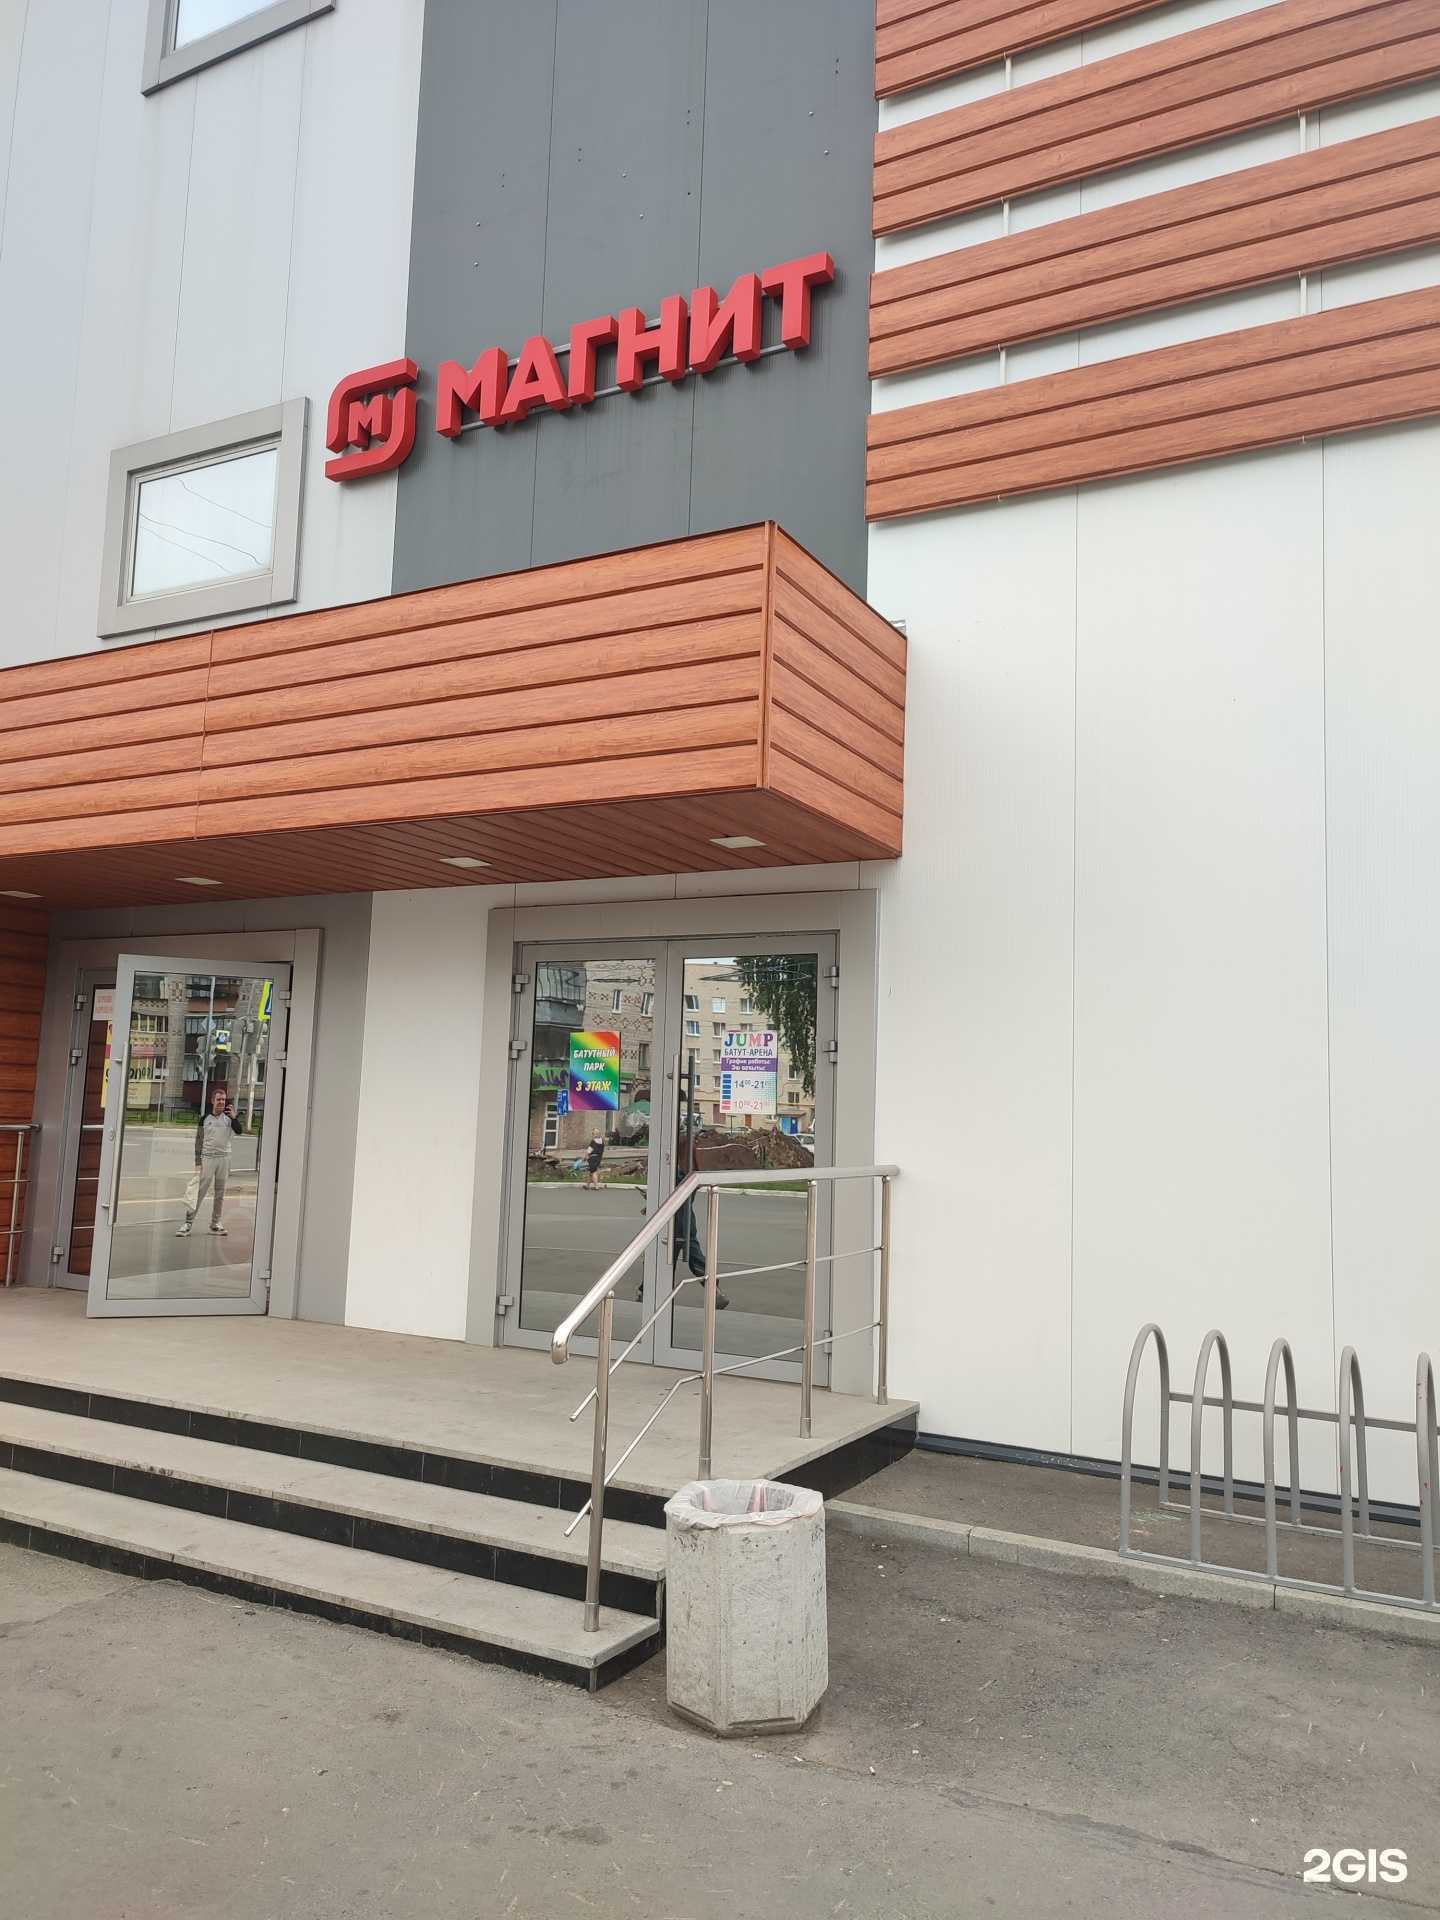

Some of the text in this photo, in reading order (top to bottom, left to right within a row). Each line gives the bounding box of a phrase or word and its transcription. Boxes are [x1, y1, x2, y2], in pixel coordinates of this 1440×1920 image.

[436, 251, 834, 438] МАГНИТ
[724, 1033, 773, 1047] JUMP
[573, 1047, 616, 1059] БАТУТНЫЙ
[724, 1048, 773, 1057] БАТУТ-АРЕНА
[583, 1062, 605, 1072] ПАРК
[575, 1080, 612, 1092] 3 ЭТАЖ
